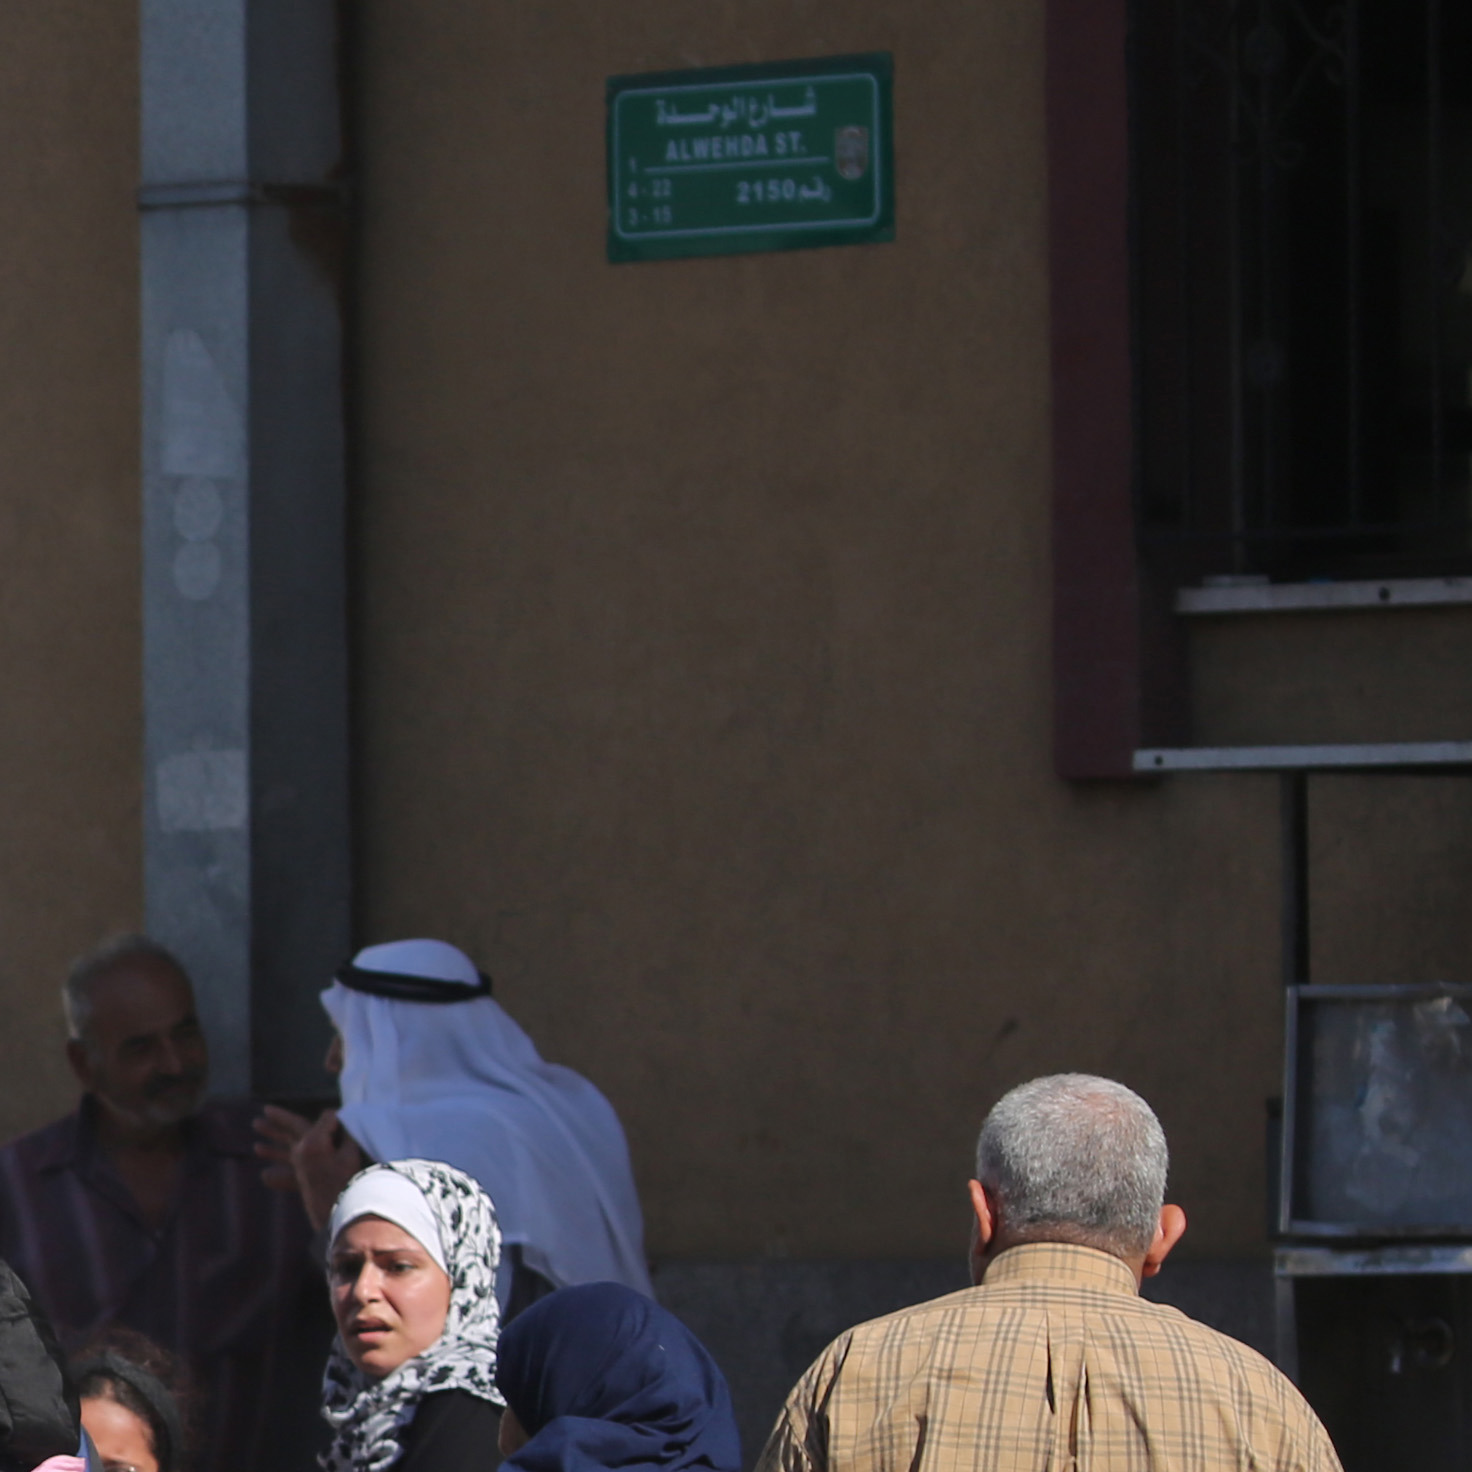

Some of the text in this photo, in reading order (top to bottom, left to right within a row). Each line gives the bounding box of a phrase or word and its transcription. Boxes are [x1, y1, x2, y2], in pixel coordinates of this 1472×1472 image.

[665, 130, 807, 161] ALWEHDA ST.
[736, 178, 796, 204] 2150
